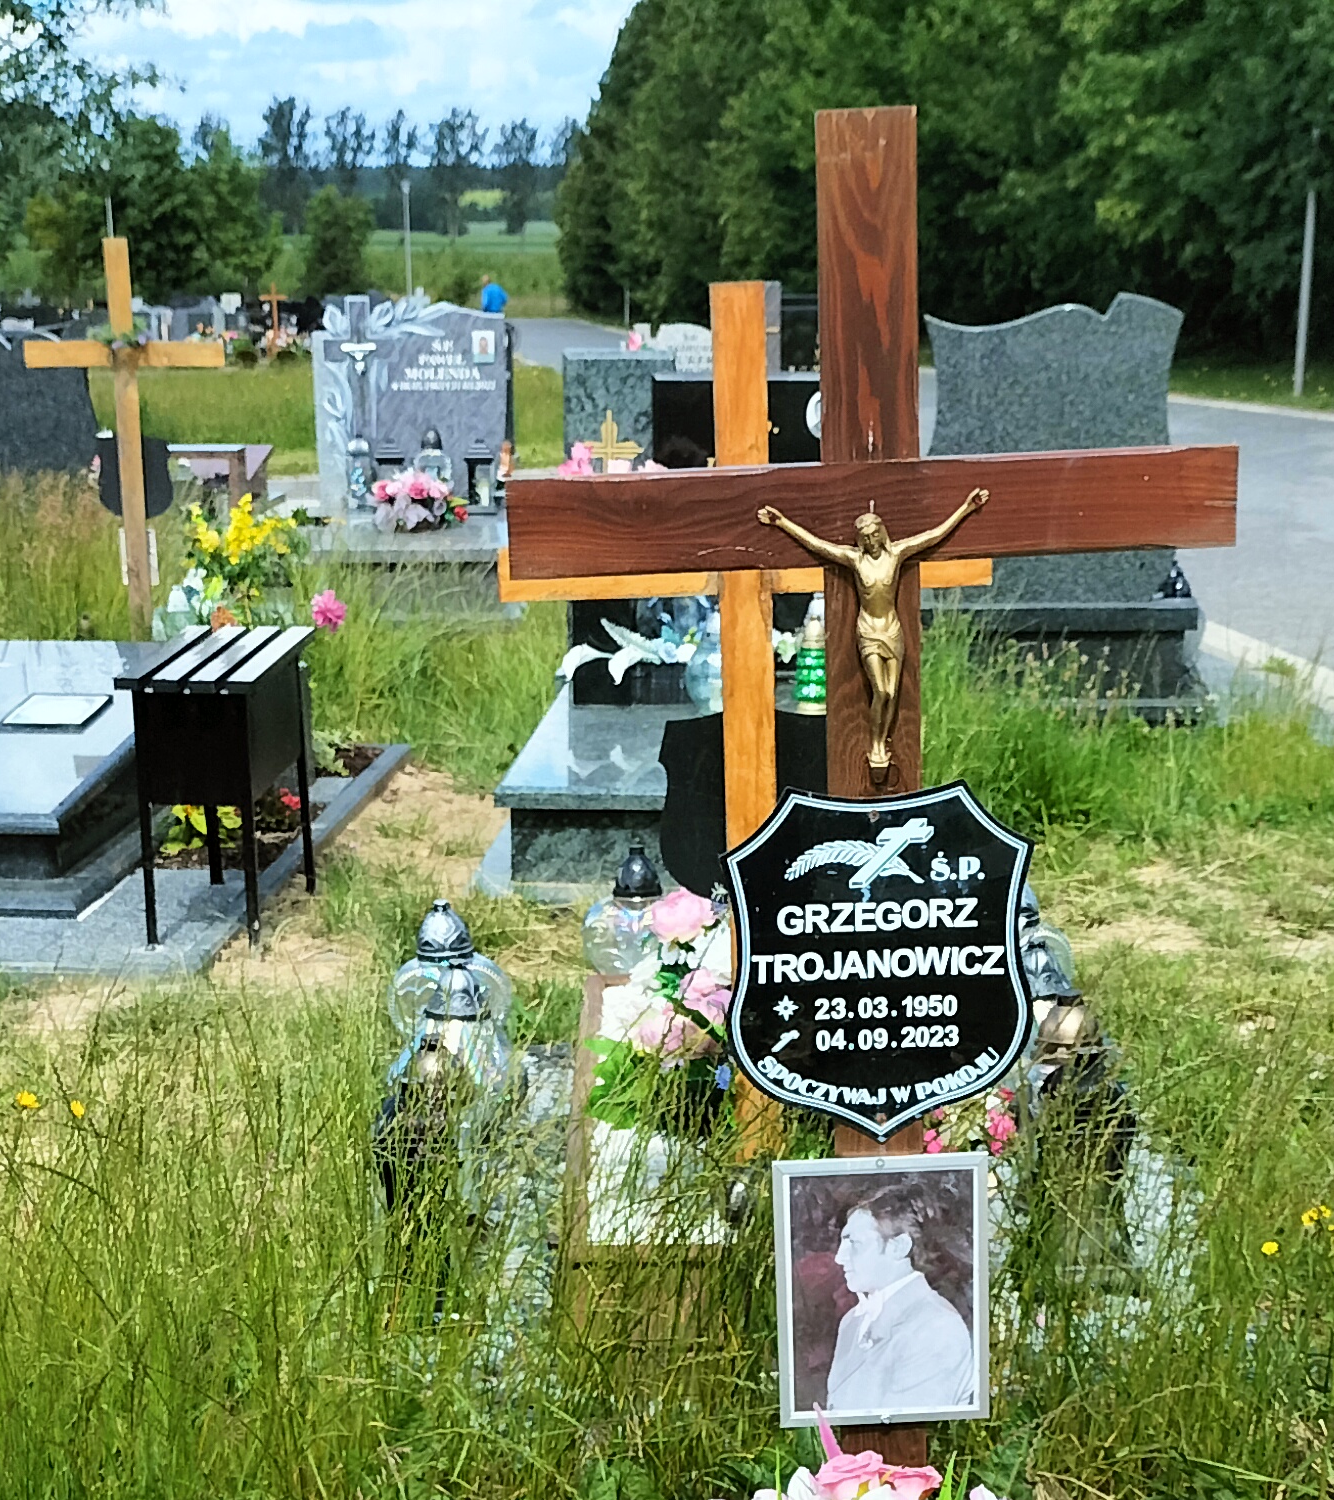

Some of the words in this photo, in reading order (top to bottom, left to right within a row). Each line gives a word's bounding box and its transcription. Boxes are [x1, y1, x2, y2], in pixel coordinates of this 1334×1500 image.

[929, 851, 986, 882] Ś.P.
[776, 897, 979, 936] GRZEGORZ
[751, 945, 1005, 984] TROJANOWICZ
[814, 994, 958, 1021] 23.03.1950
[815, 1024, 960, 1052] 04.09.2023
[757, 1055, 887, 1106] SPOCZYWAJ
[890, 1084, 912, 1104] W
[915, 1046, 1001, 1100] POKOJU
